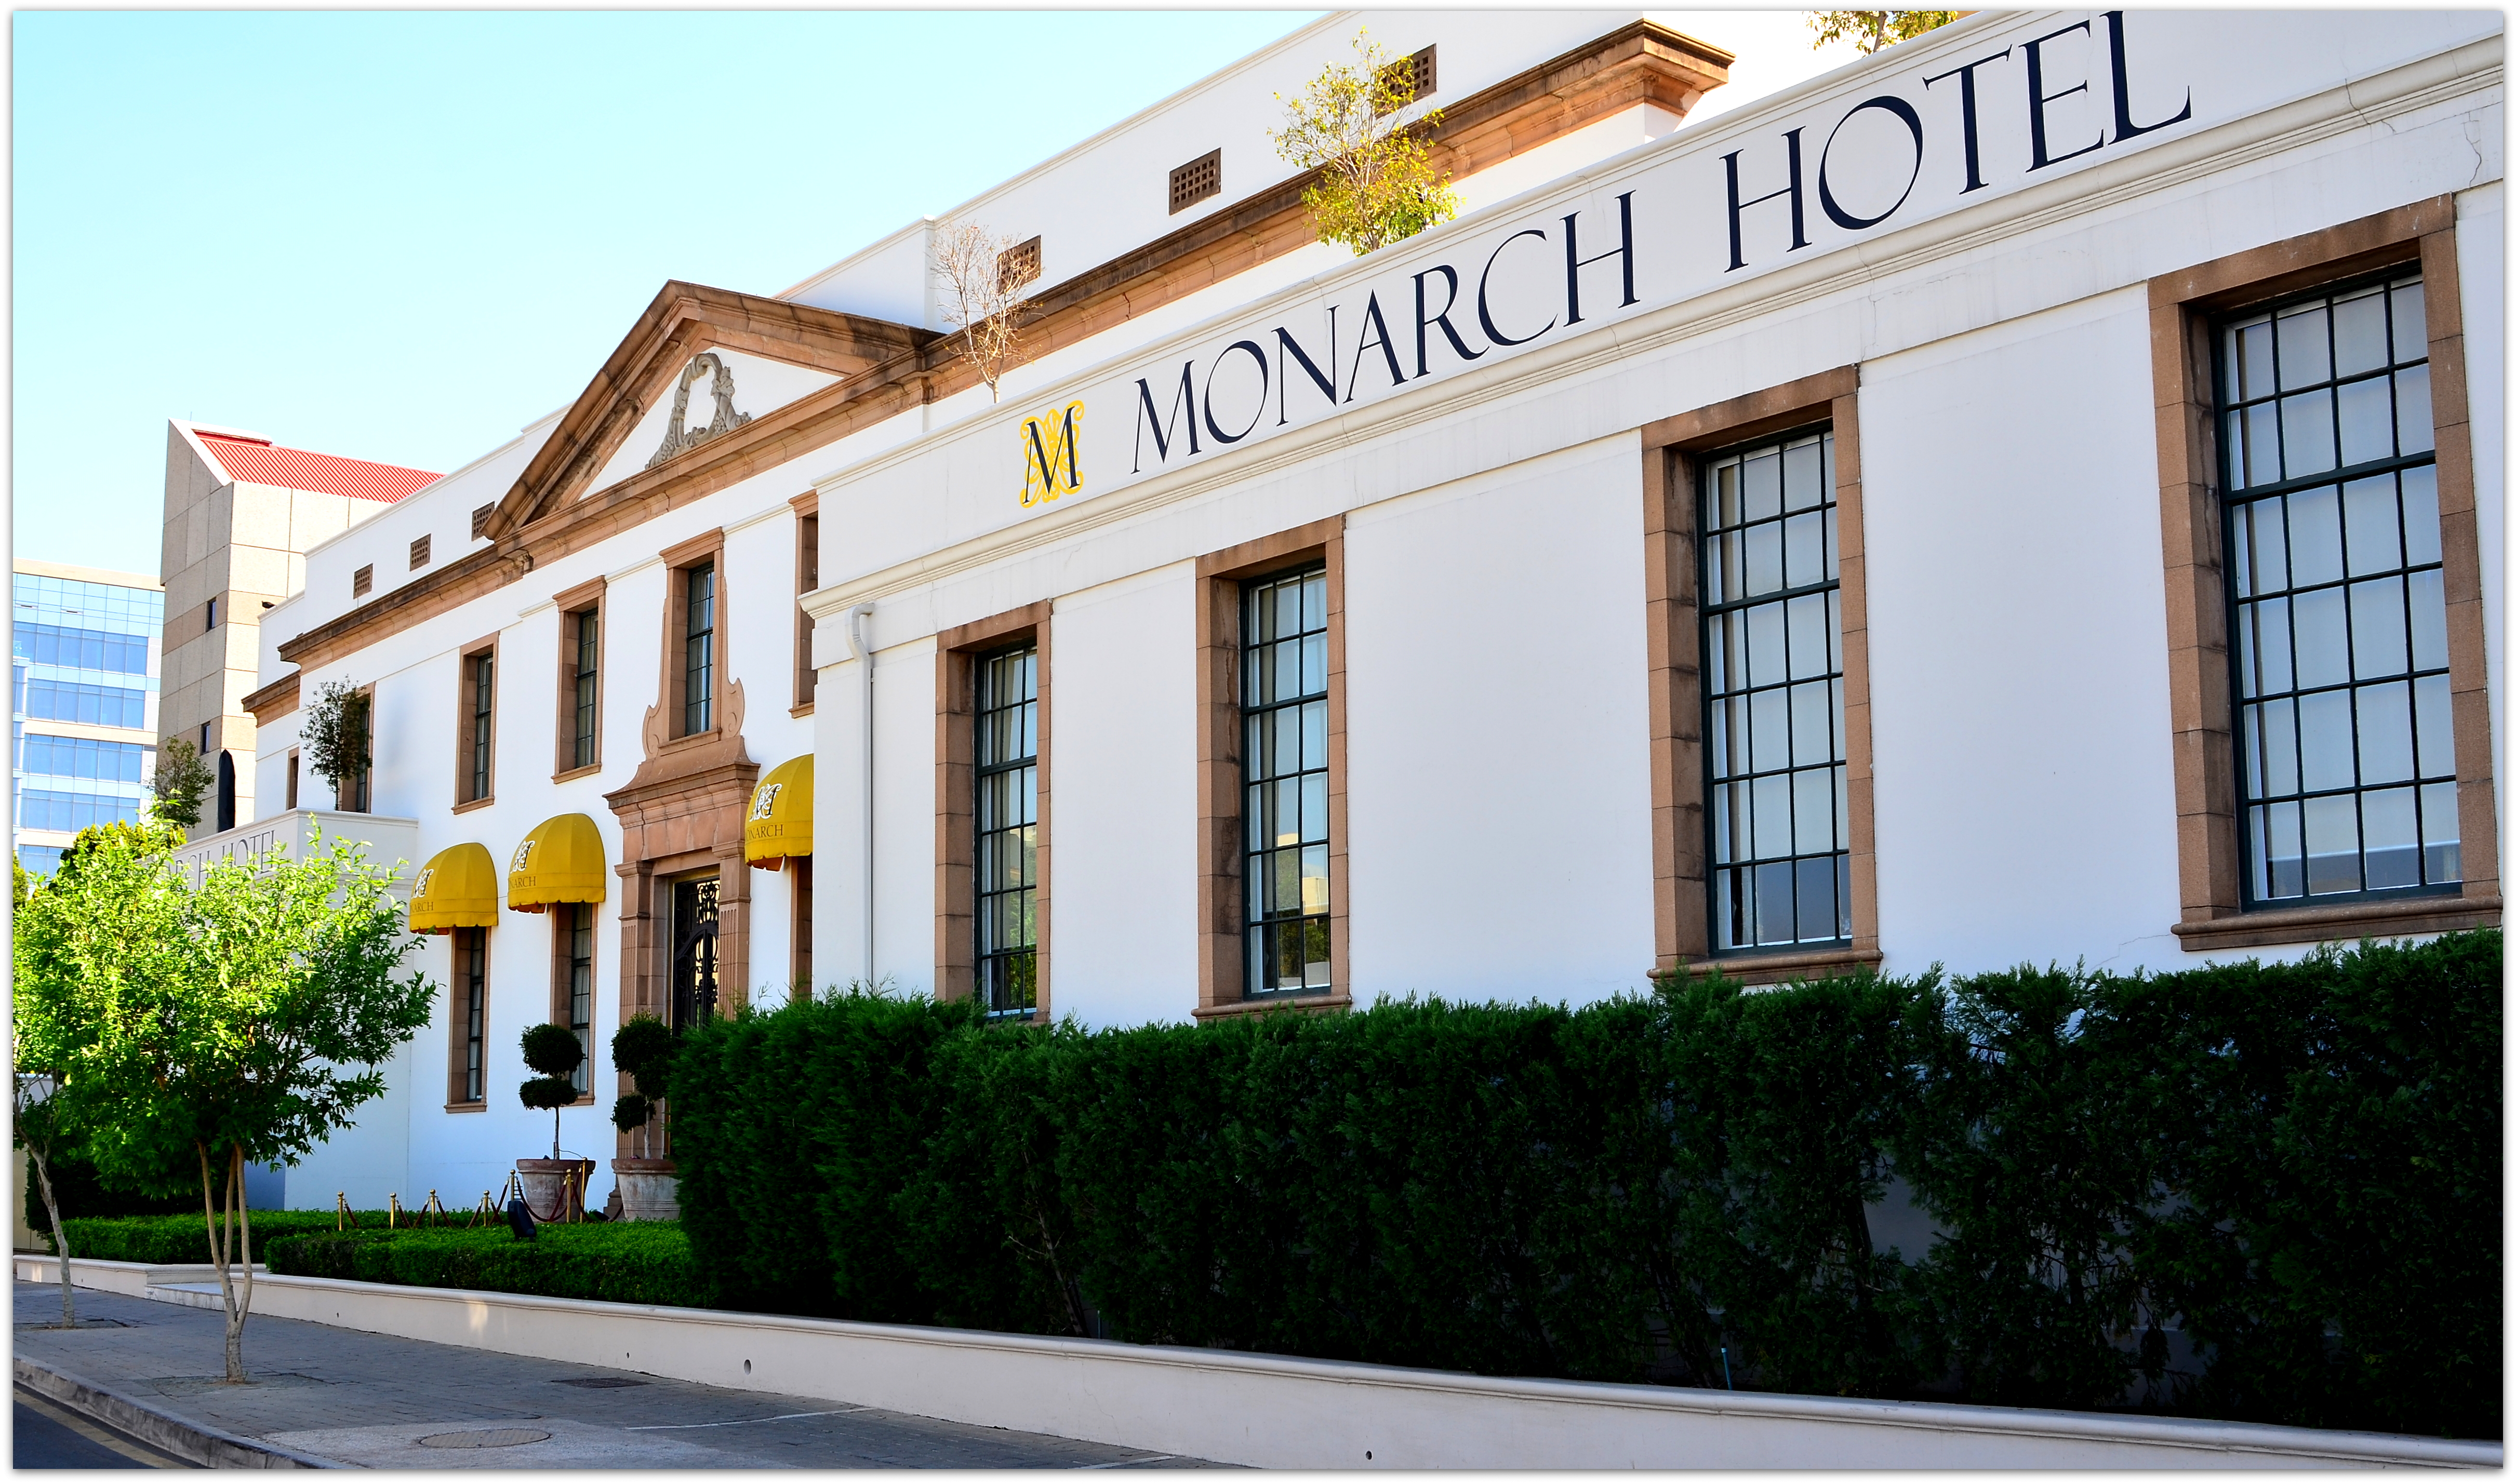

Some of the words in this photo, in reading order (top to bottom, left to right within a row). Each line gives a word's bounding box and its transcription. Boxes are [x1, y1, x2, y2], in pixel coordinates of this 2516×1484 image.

[1130, 189, 1641, 475] MONARCH
[1719, 10, 2192, 273] HOTEL
[747, 824, 783, 841] ONARCH
